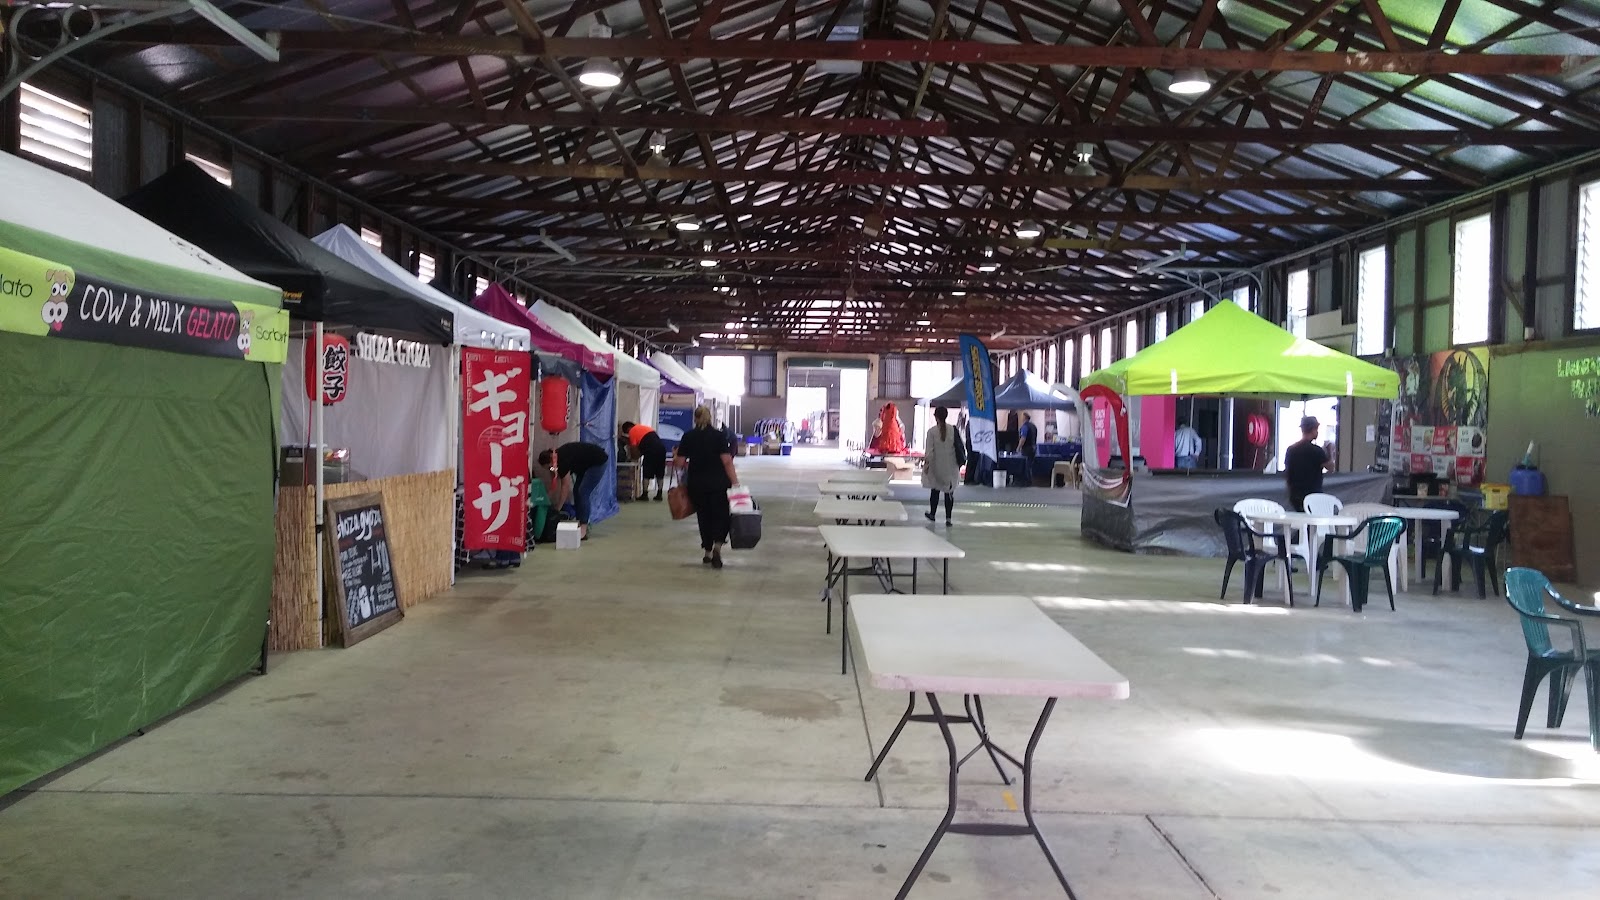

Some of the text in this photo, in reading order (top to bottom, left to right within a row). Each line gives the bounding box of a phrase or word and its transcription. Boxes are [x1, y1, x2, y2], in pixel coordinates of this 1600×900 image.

[79, 284, 236, 341] COW & MILK GELATO
[323, 343, 346, 399] 餃子
[470, 367, 526, 534] ギョーザ
